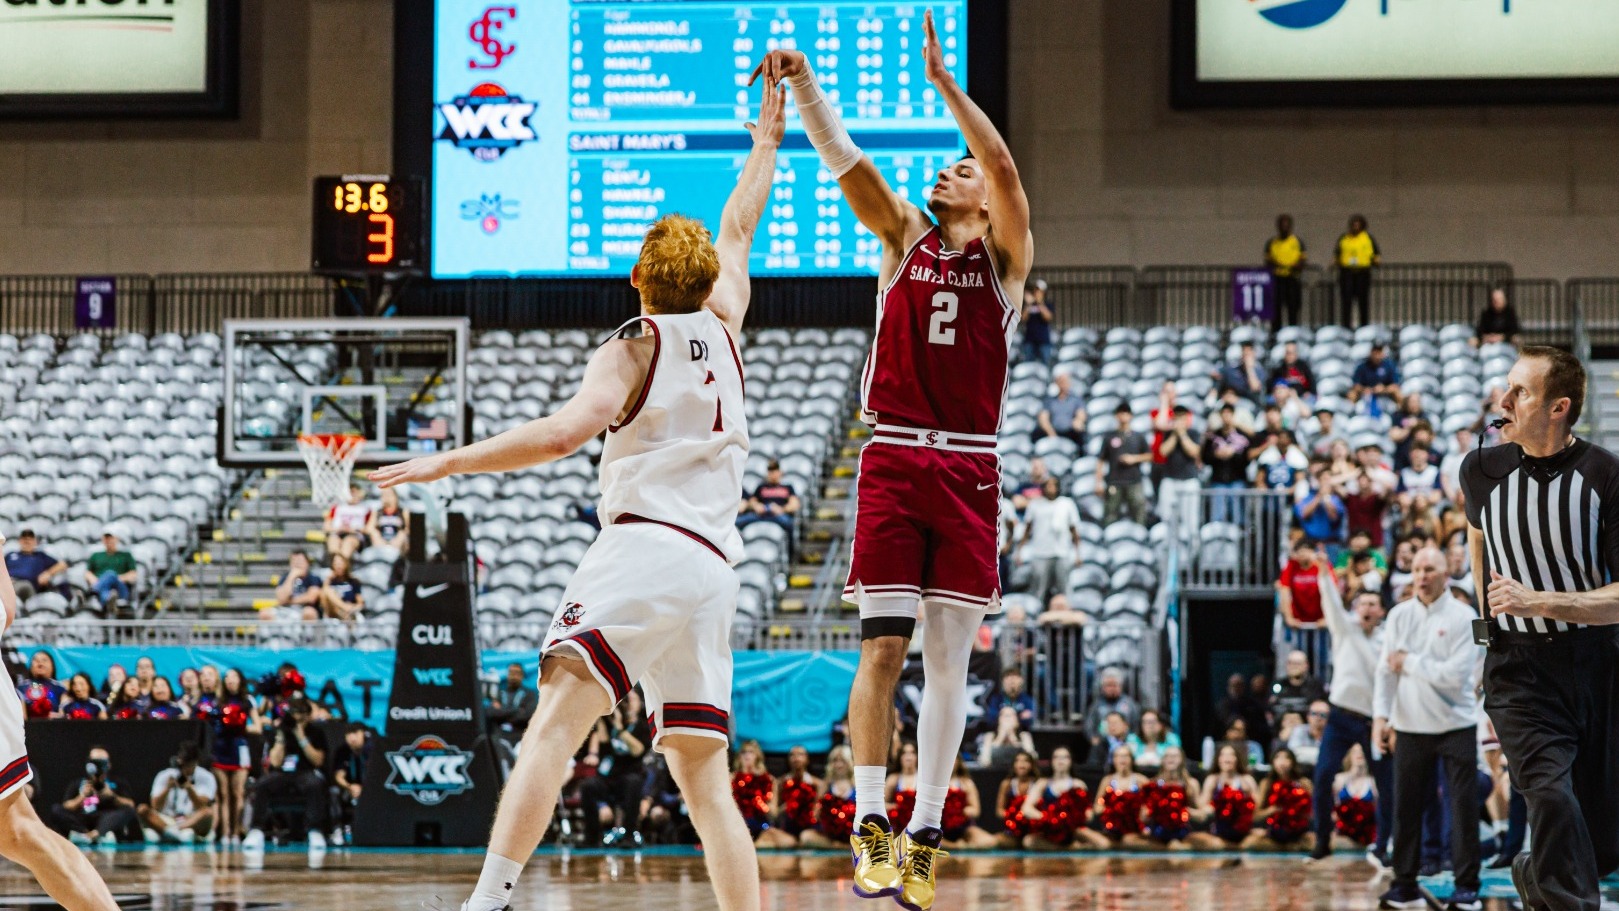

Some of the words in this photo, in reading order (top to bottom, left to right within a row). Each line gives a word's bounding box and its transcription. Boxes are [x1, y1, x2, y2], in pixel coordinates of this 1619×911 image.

[441, 104, 534, 139] WCC
[570, 134, 620, 150] SAINT
[623, 134, 686, 150] MARY'S
[335, 183, 389, 213] 13.6
[368, 214, 394, 262] 3
[948, 270, 984, 288] CLARA
[88, 292, 102, 320] 9
[1242, 284, 1264, 312] 11
[928, 291, 959, 346] 2
[412, 624, 454, 645] CU1
[412, 667, 454, 686] WCC
[390, 706, 427, 720] Credit
[393, 755, 468, 784] WCC
